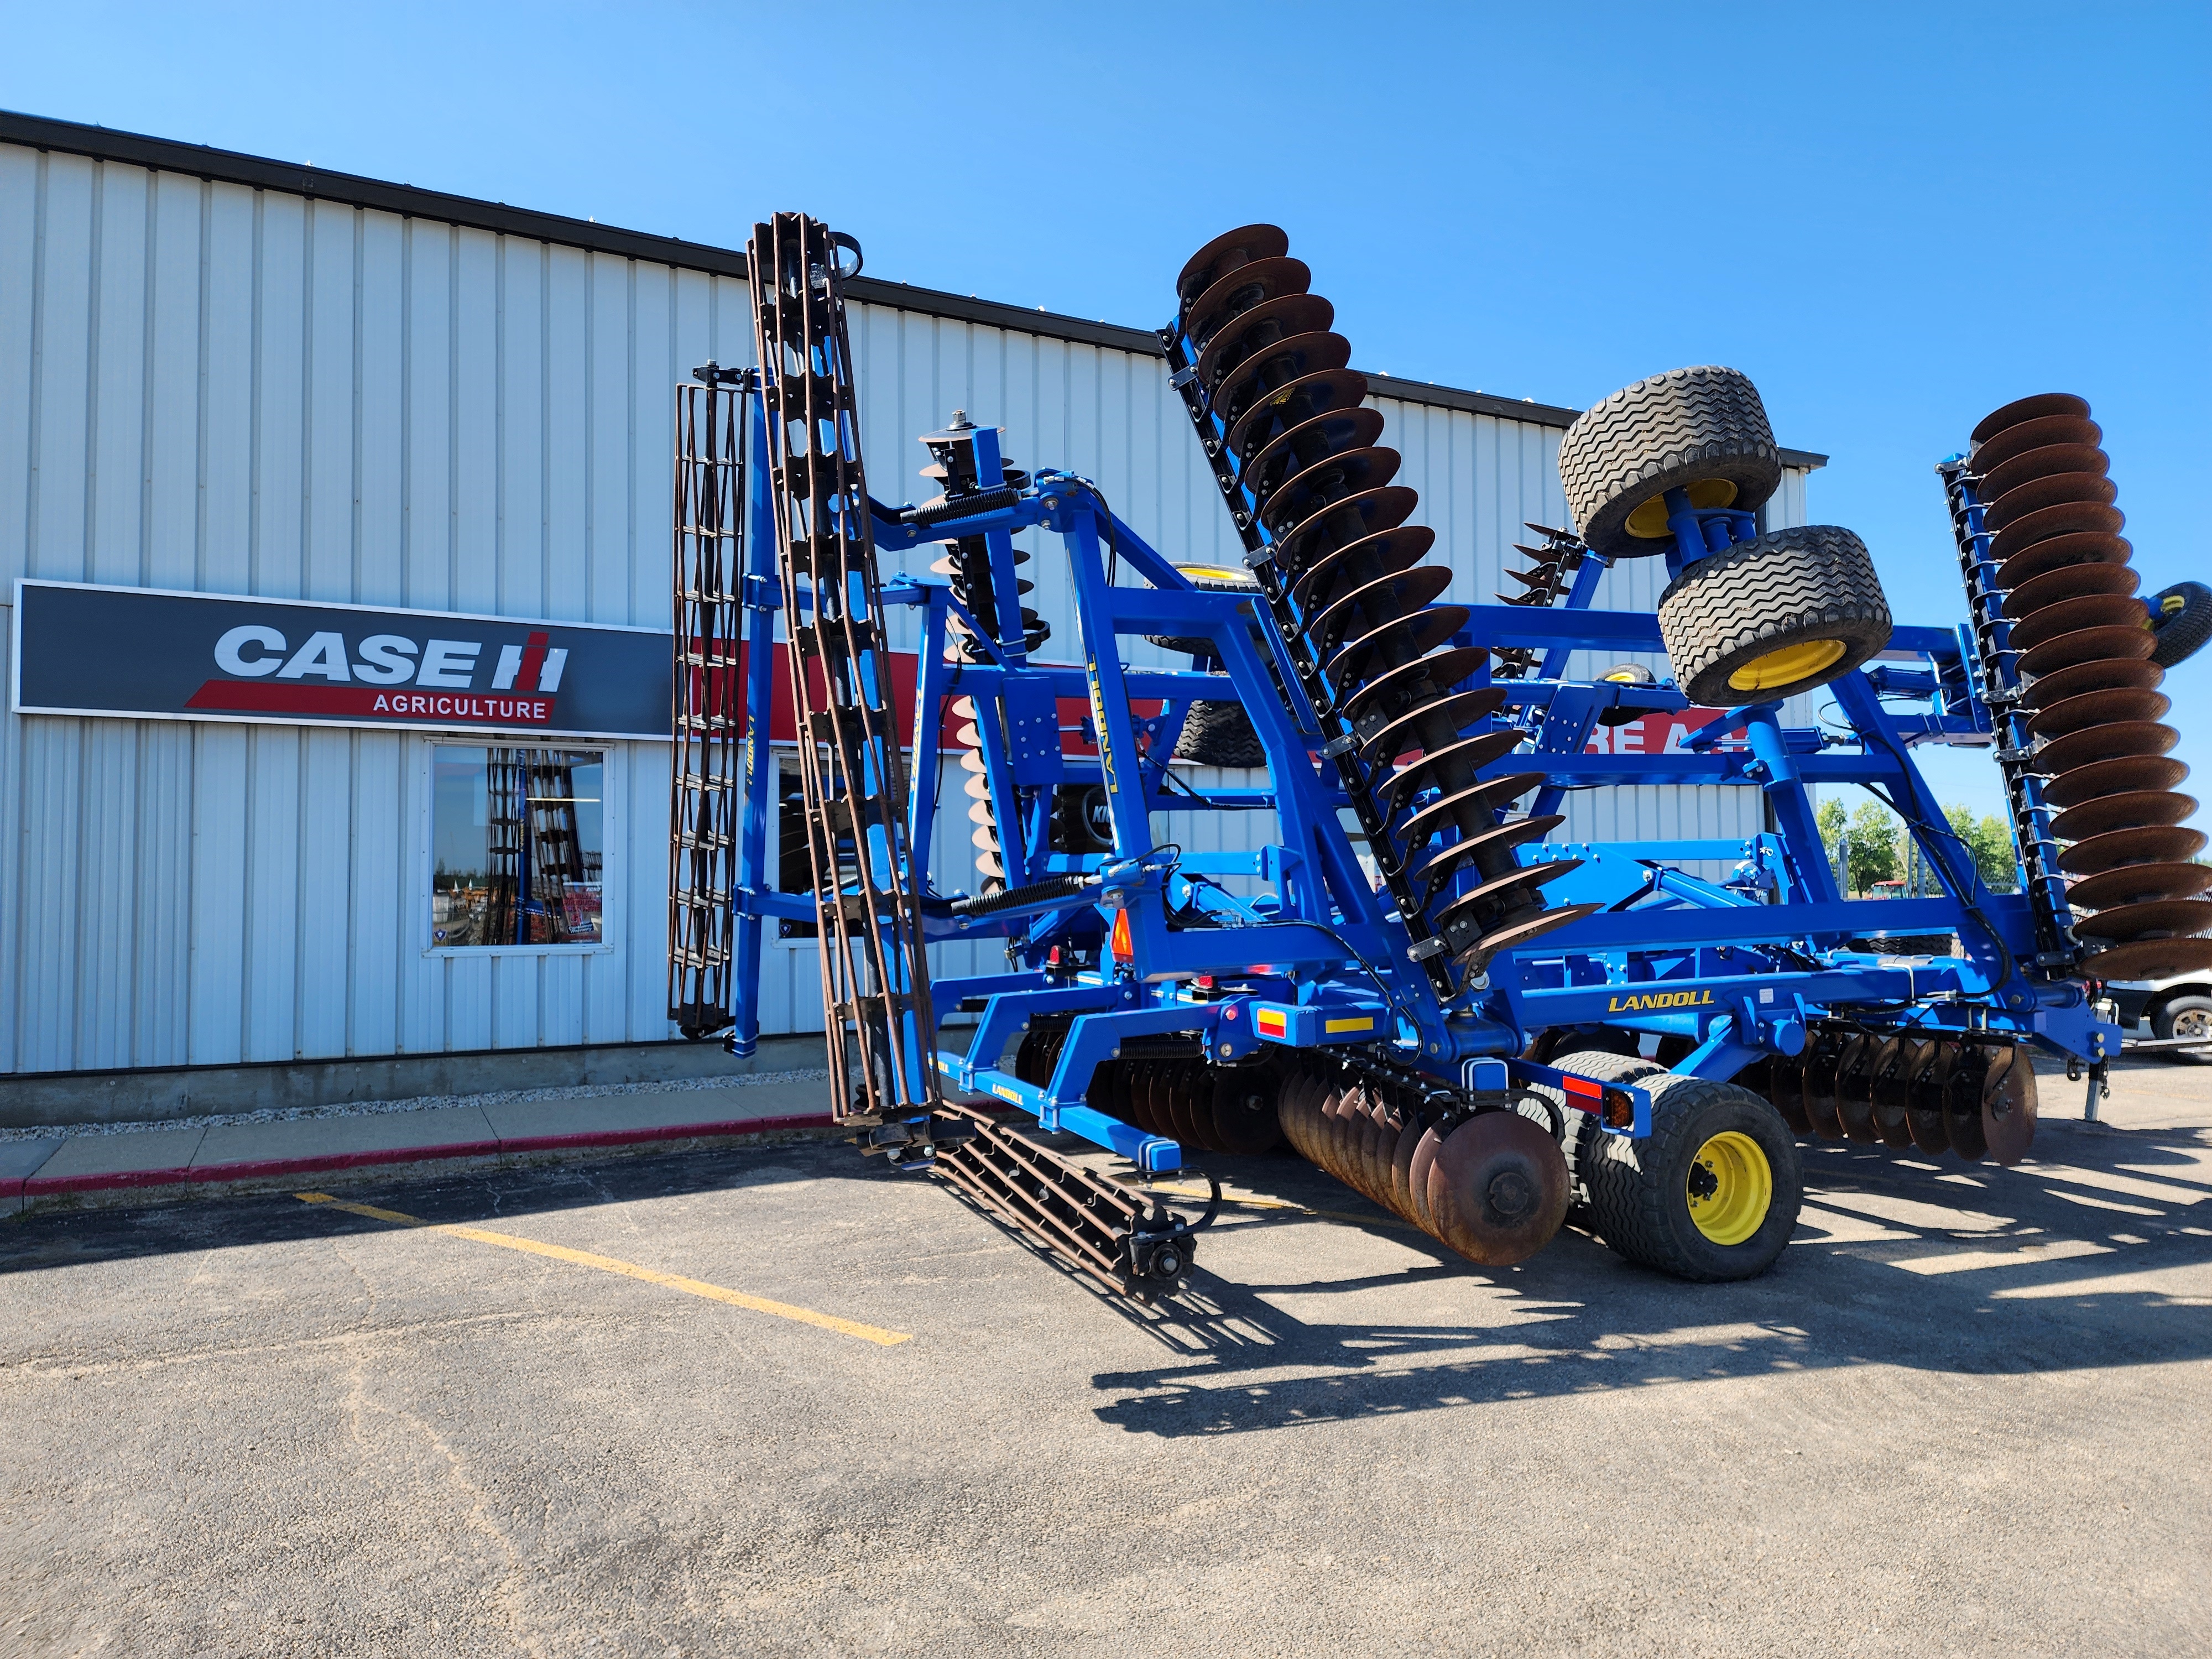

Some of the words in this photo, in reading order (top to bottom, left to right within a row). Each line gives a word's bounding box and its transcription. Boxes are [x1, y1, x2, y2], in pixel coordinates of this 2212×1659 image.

[213, 624, 482, 688] CASE
[373, 694, 546, 719] AGRICULTURE
[1089, 653, 1118, 794] LANDOLL
[1608, 989, 1715, 1013] LANDOLL
[992, 1082, 1024, 1105] LANDOLL
